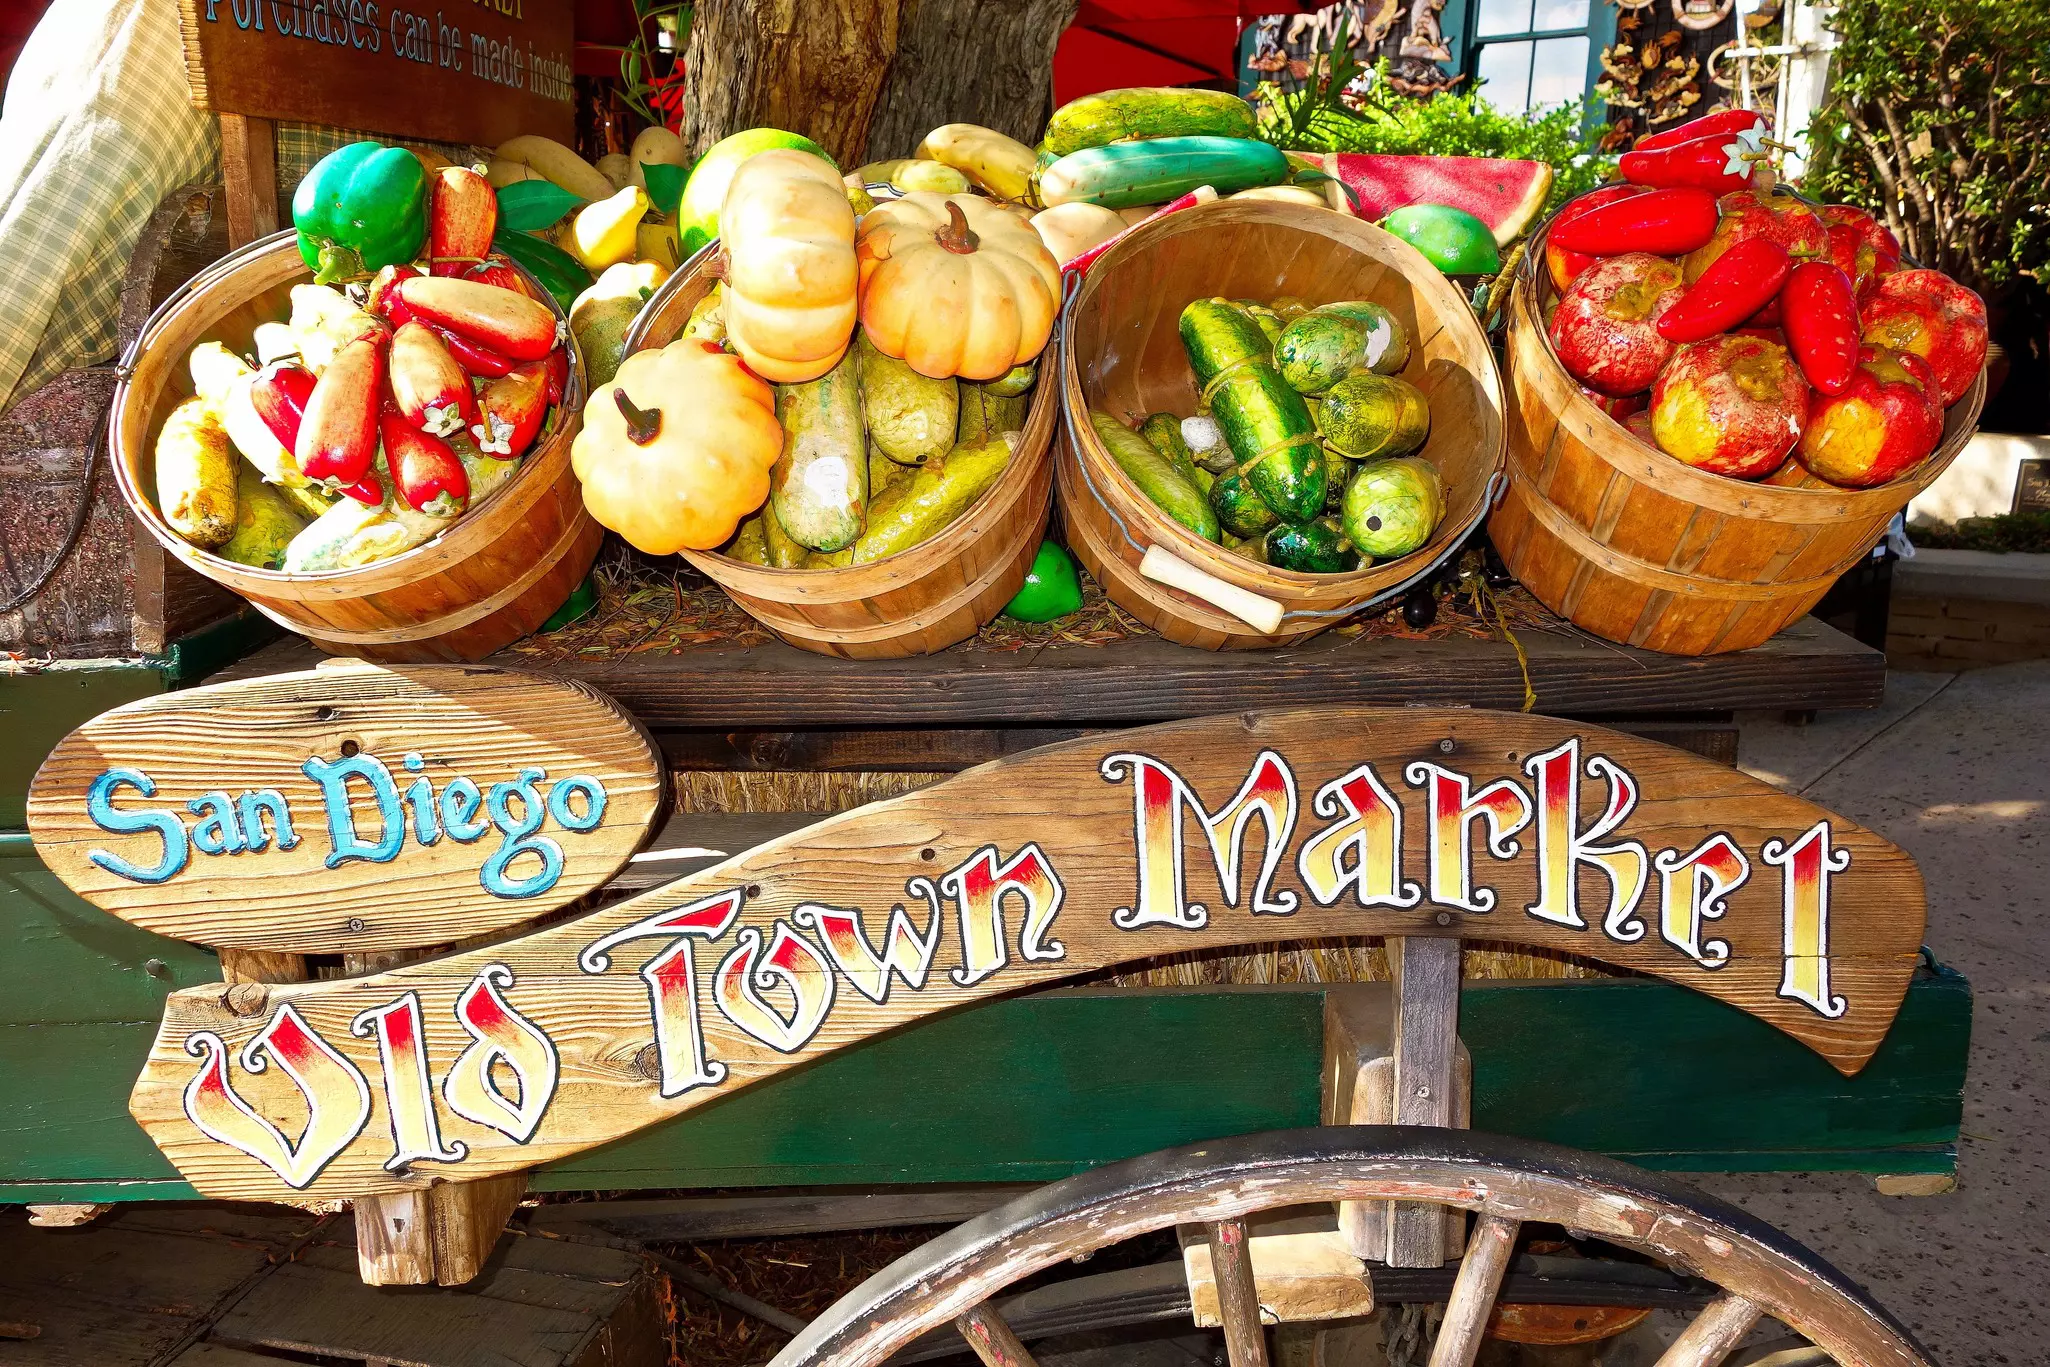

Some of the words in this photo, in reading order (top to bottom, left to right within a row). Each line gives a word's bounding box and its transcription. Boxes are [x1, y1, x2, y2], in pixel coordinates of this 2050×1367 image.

[390, 9, 432, 64] can
[437, 11, 463, 72] be
[470, 35, 524, 89] made
[528, 41, 574, 101] inside
[87, 767, 301, 884] San
[301, 752, 607, 898] Diego
[183, 964, 560, 1189] Old
[578, 841, 1066, 1098] Town
[1099, 737, 1852, 1019] Market
